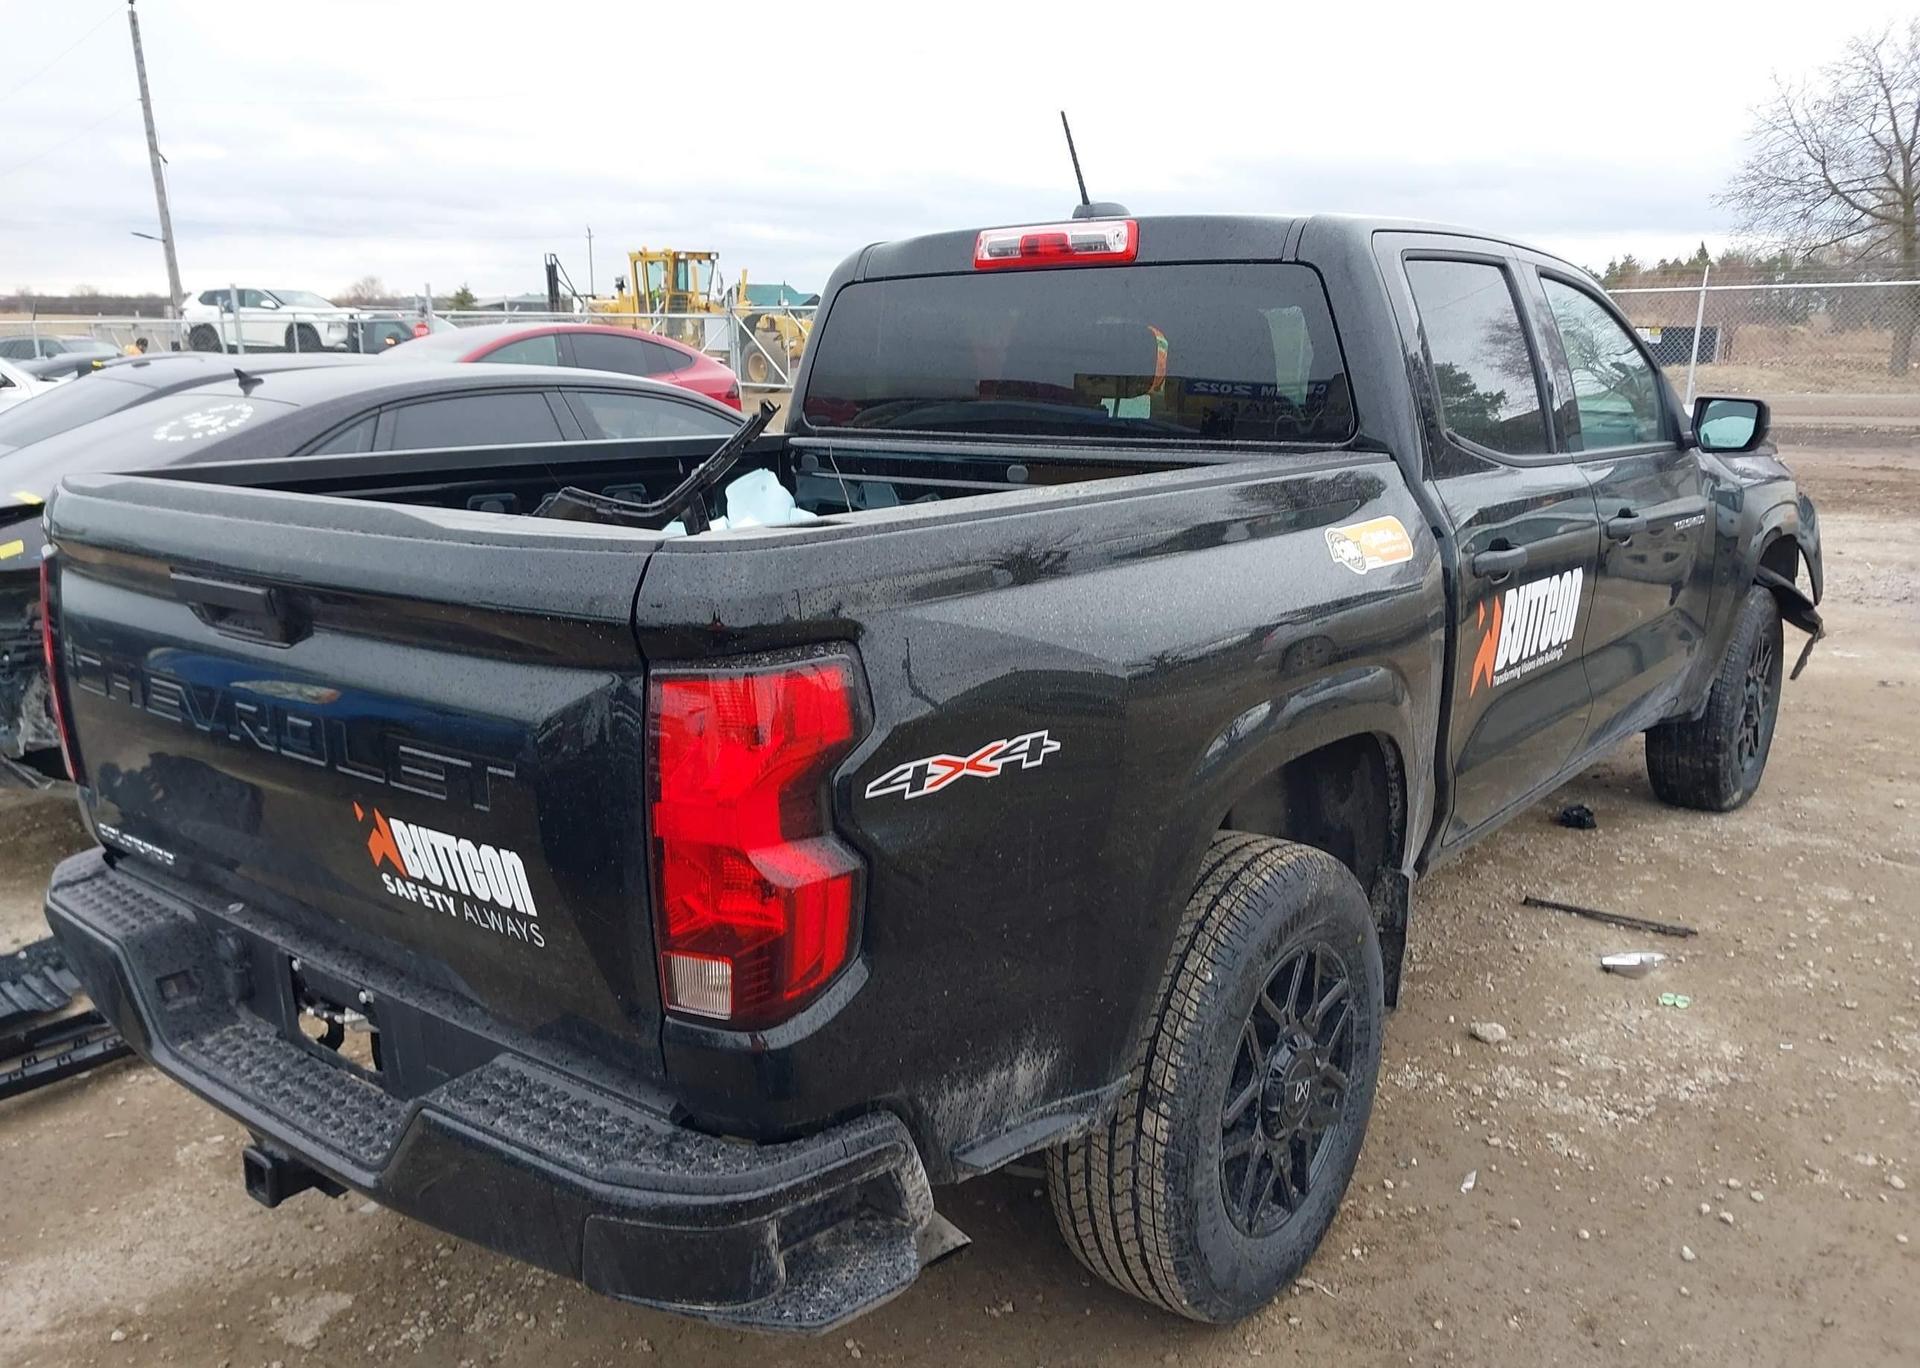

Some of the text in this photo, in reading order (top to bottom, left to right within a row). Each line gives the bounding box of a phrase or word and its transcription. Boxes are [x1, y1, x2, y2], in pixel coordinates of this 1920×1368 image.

[1494, 567, 1584, 671] BUTTCON
[66, 638, 516, 811] CHEVROLET
[381, 872, 545, 948] SAFETY ALWAYS
[388, 817, 538, 917] BUTTCON
